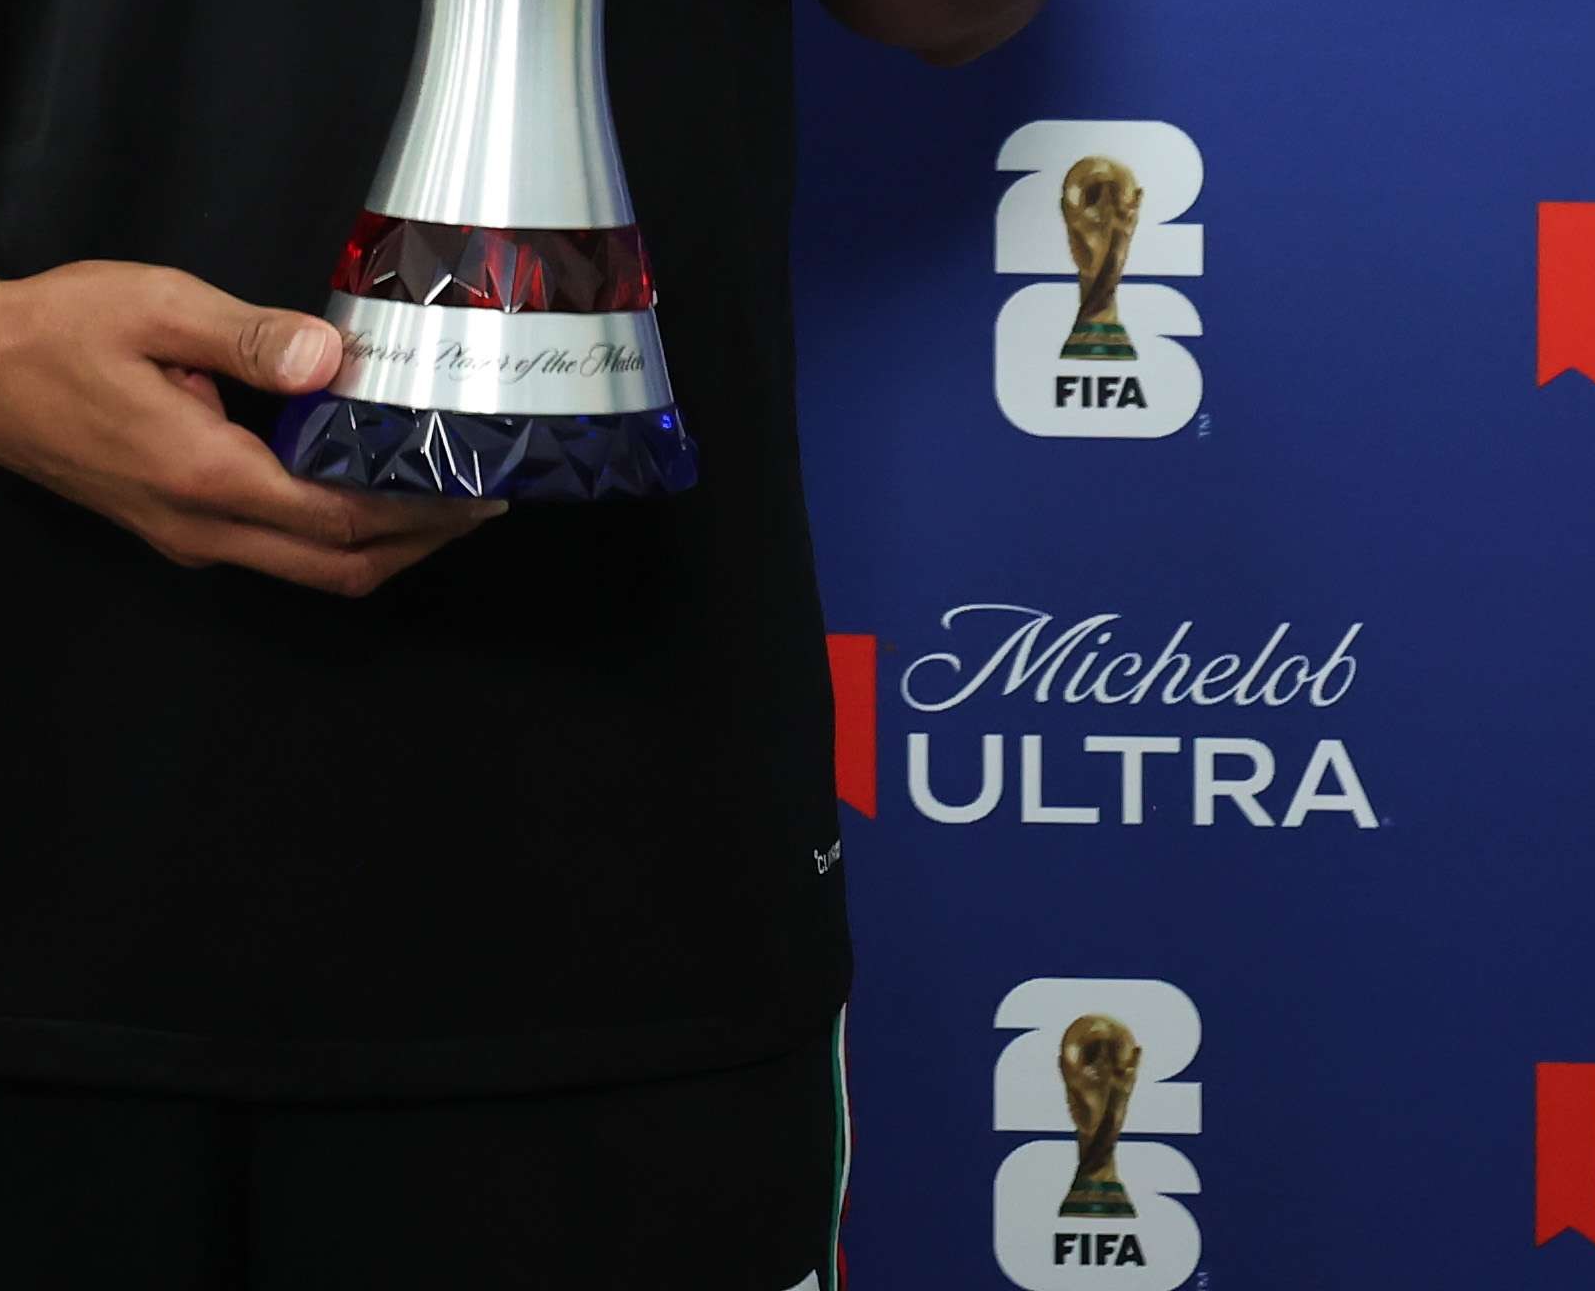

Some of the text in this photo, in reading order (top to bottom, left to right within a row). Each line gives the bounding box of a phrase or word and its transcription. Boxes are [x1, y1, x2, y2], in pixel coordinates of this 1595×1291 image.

[502, 349, 550, 383] of
[540, 349, 578, 373] the
[580, 342, 645, 376] Match
[1055, 375, 1149, 409] FIFA
[901, 604, 1363, 711] Michelob
[908, 733, 1379, 828] ULTRA
[1053, 1232, 1147, 1267] FIFA
